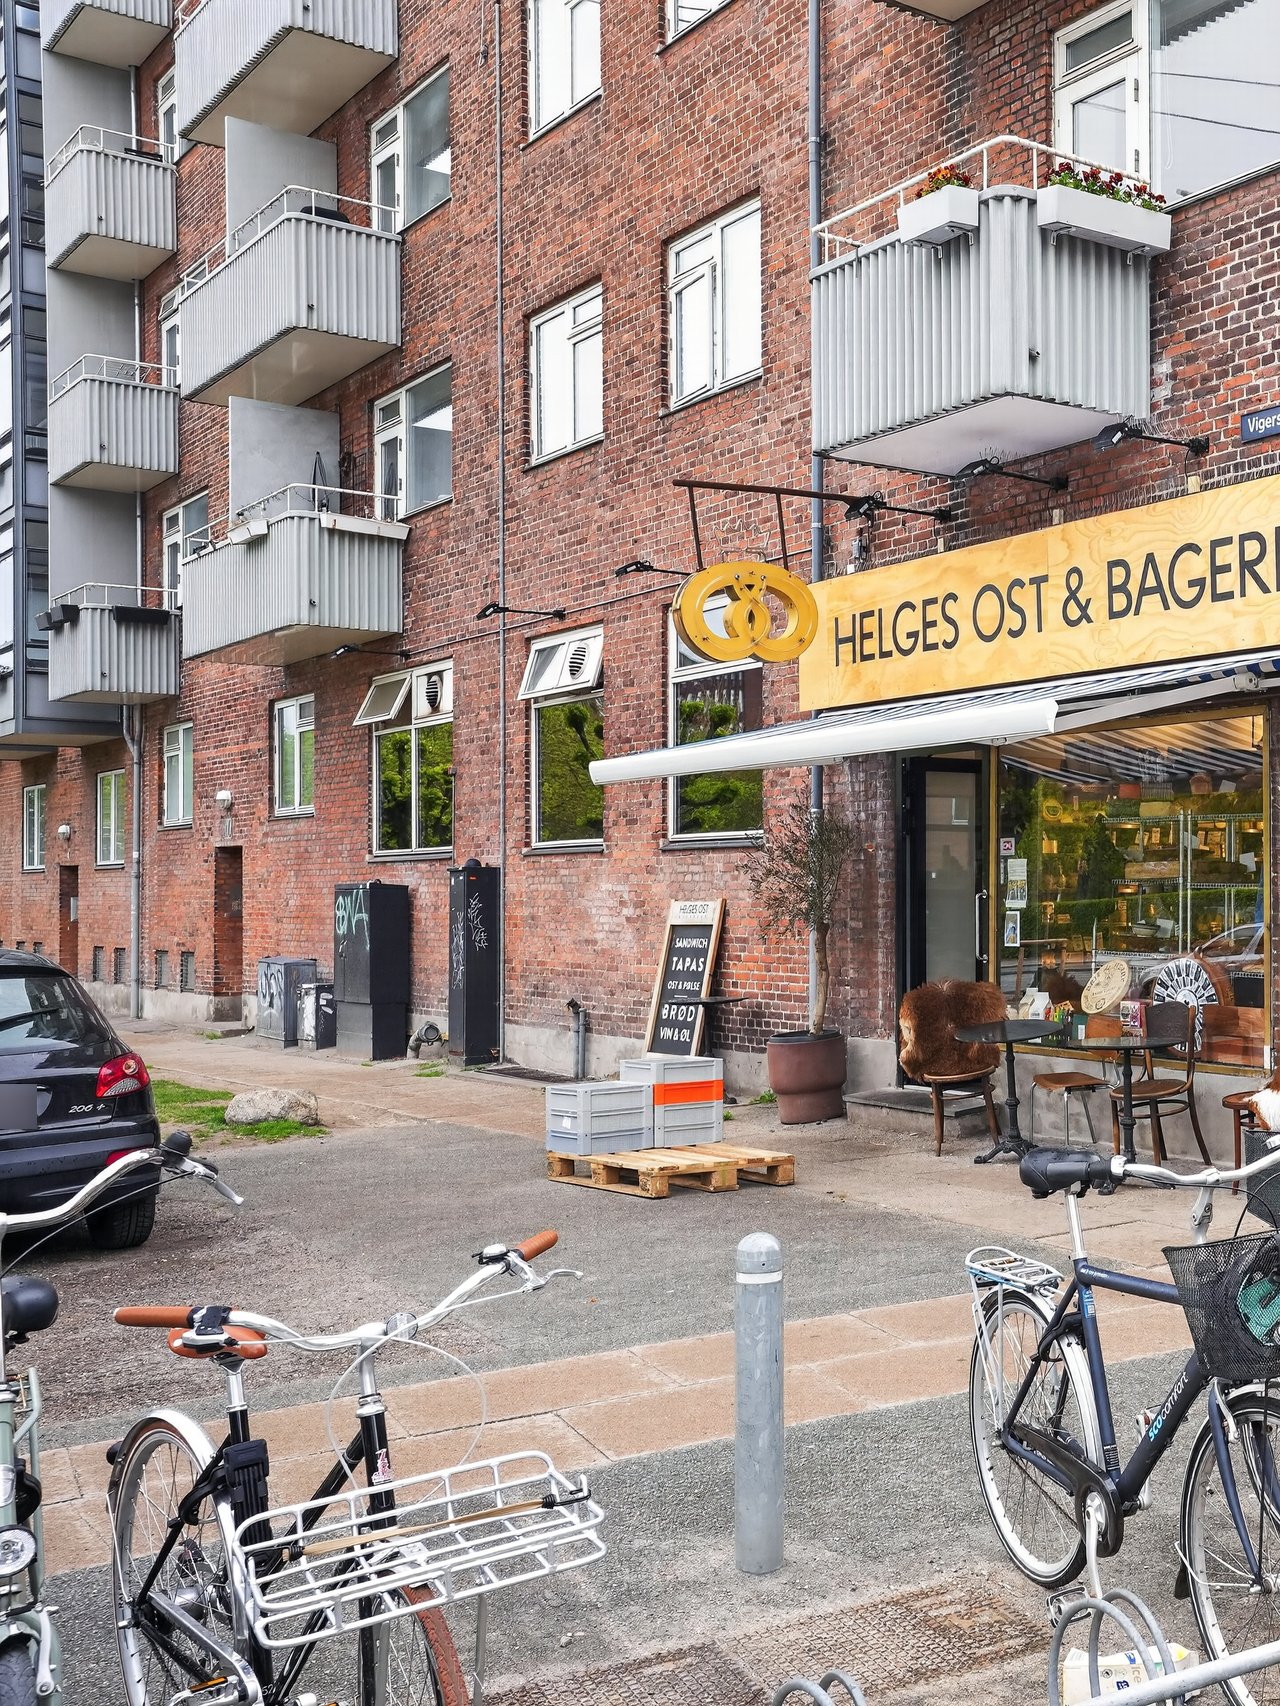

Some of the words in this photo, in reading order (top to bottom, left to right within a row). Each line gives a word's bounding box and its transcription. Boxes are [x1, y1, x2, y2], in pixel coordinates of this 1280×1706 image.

[834, 591, 960, 668] HELGES
[972, 574, 1049, 644] OST
[1061, 566, 1094, 628] &
[698, 903, 710, 914] OST
[674, 937, 708, 949] SANDWICH
[671, 956, 705, 972] TAPAS
[667, 980, 678, 990] OST
[683, 981, 701, 991] PØLSE
[661, 1004, 695, 1022] BRØD
[660, 1026, 673, 1041] VIN
[673, 1028, 679, 1041] &
[680, 1028, 691, 1042] ØL
[68, 1103, 94, 1114] 206
